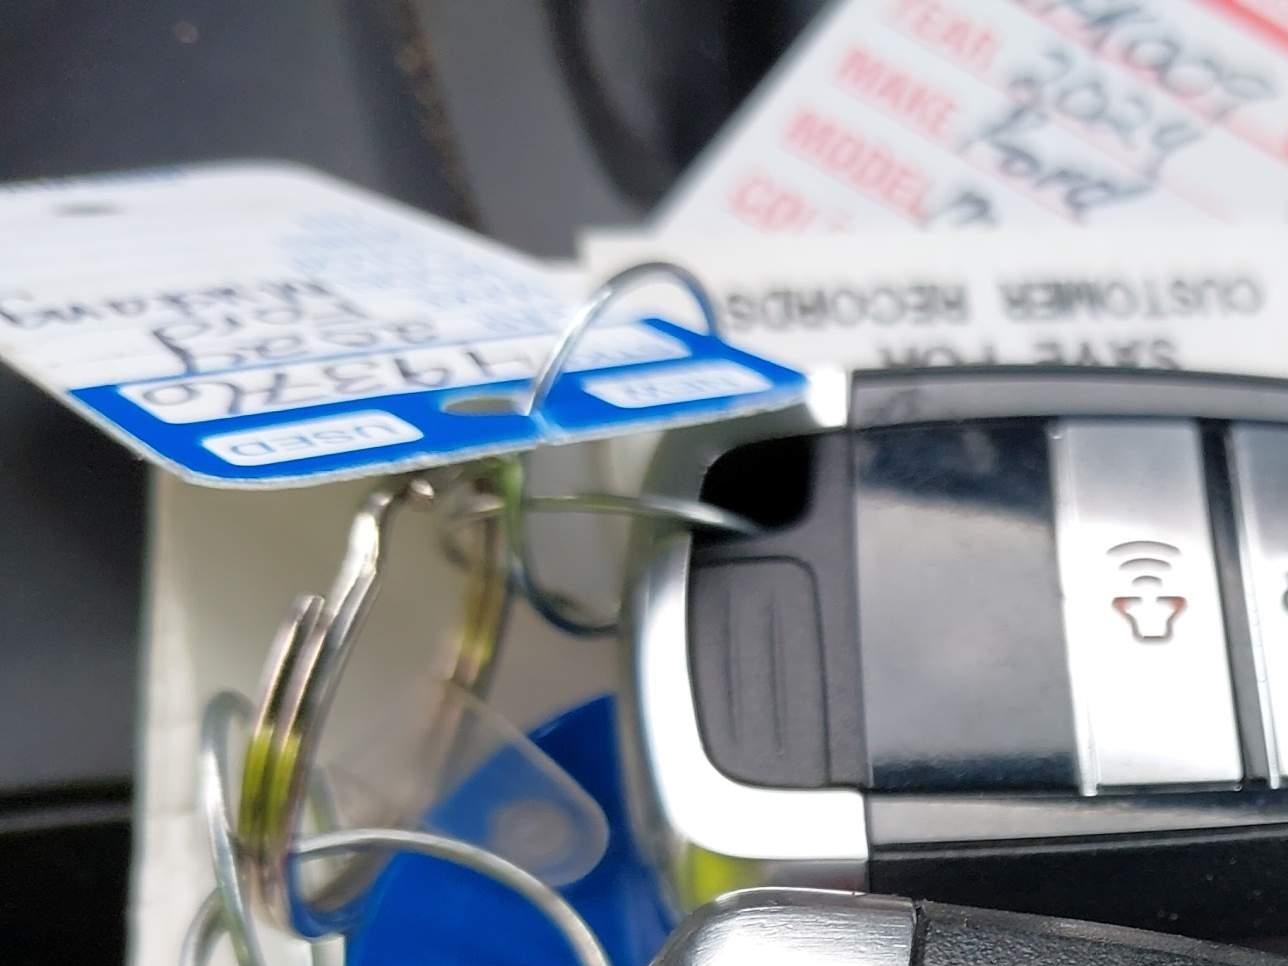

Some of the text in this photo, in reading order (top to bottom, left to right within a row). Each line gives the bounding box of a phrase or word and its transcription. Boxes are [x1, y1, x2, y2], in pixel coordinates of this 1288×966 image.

[837, 48, 954, 142] MAKE
[785, 112, 930, 228] MODEL
[722, 275, 1264, 332] CUSTOMER RECORDS
[231, 423, 400, 457] USED
